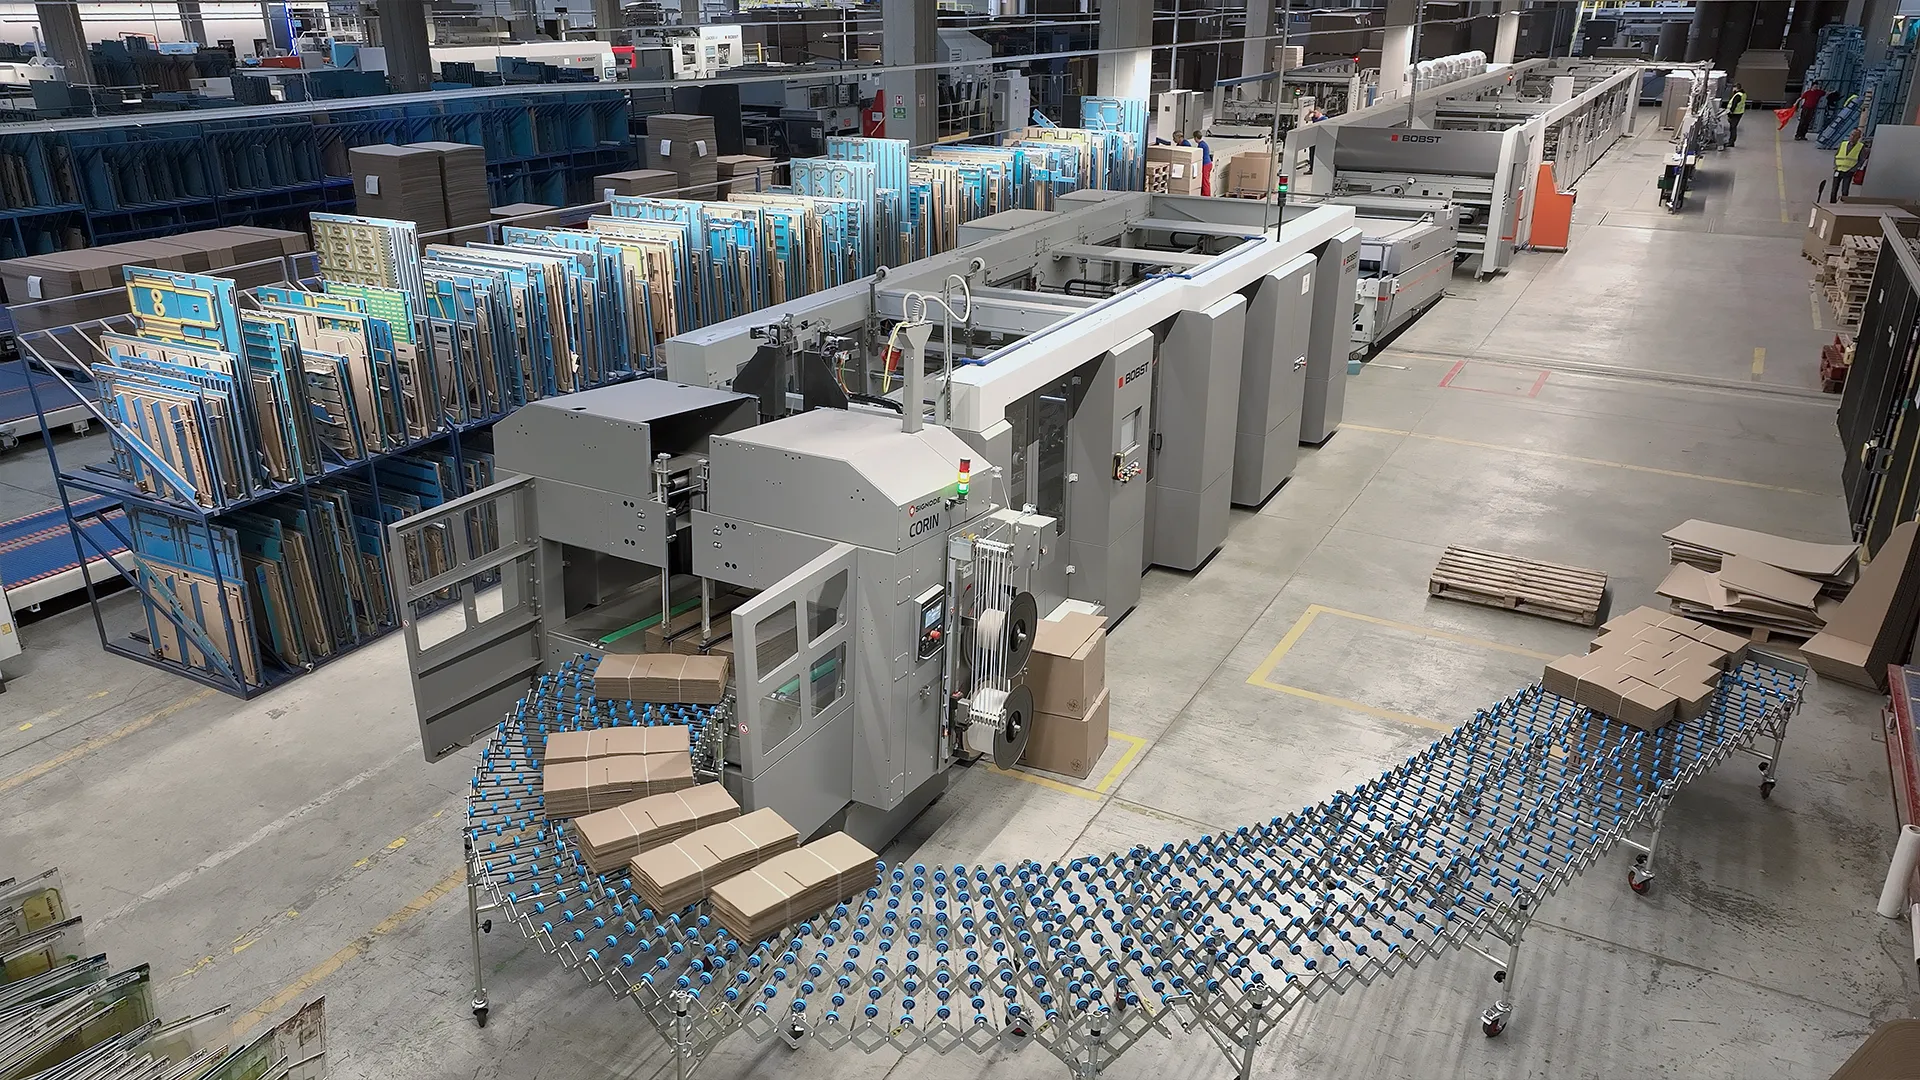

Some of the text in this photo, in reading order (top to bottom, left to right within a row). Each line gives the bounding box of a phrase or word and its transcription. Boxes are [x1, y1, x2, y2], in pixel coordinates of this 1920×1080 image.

[1402, 135, 1441, 143] BOBST
[1125, 362, 1149, 384] BOBST
[916, 497, 941, 512] SIGNODE
[910, 513, 940, 538] CORIN
